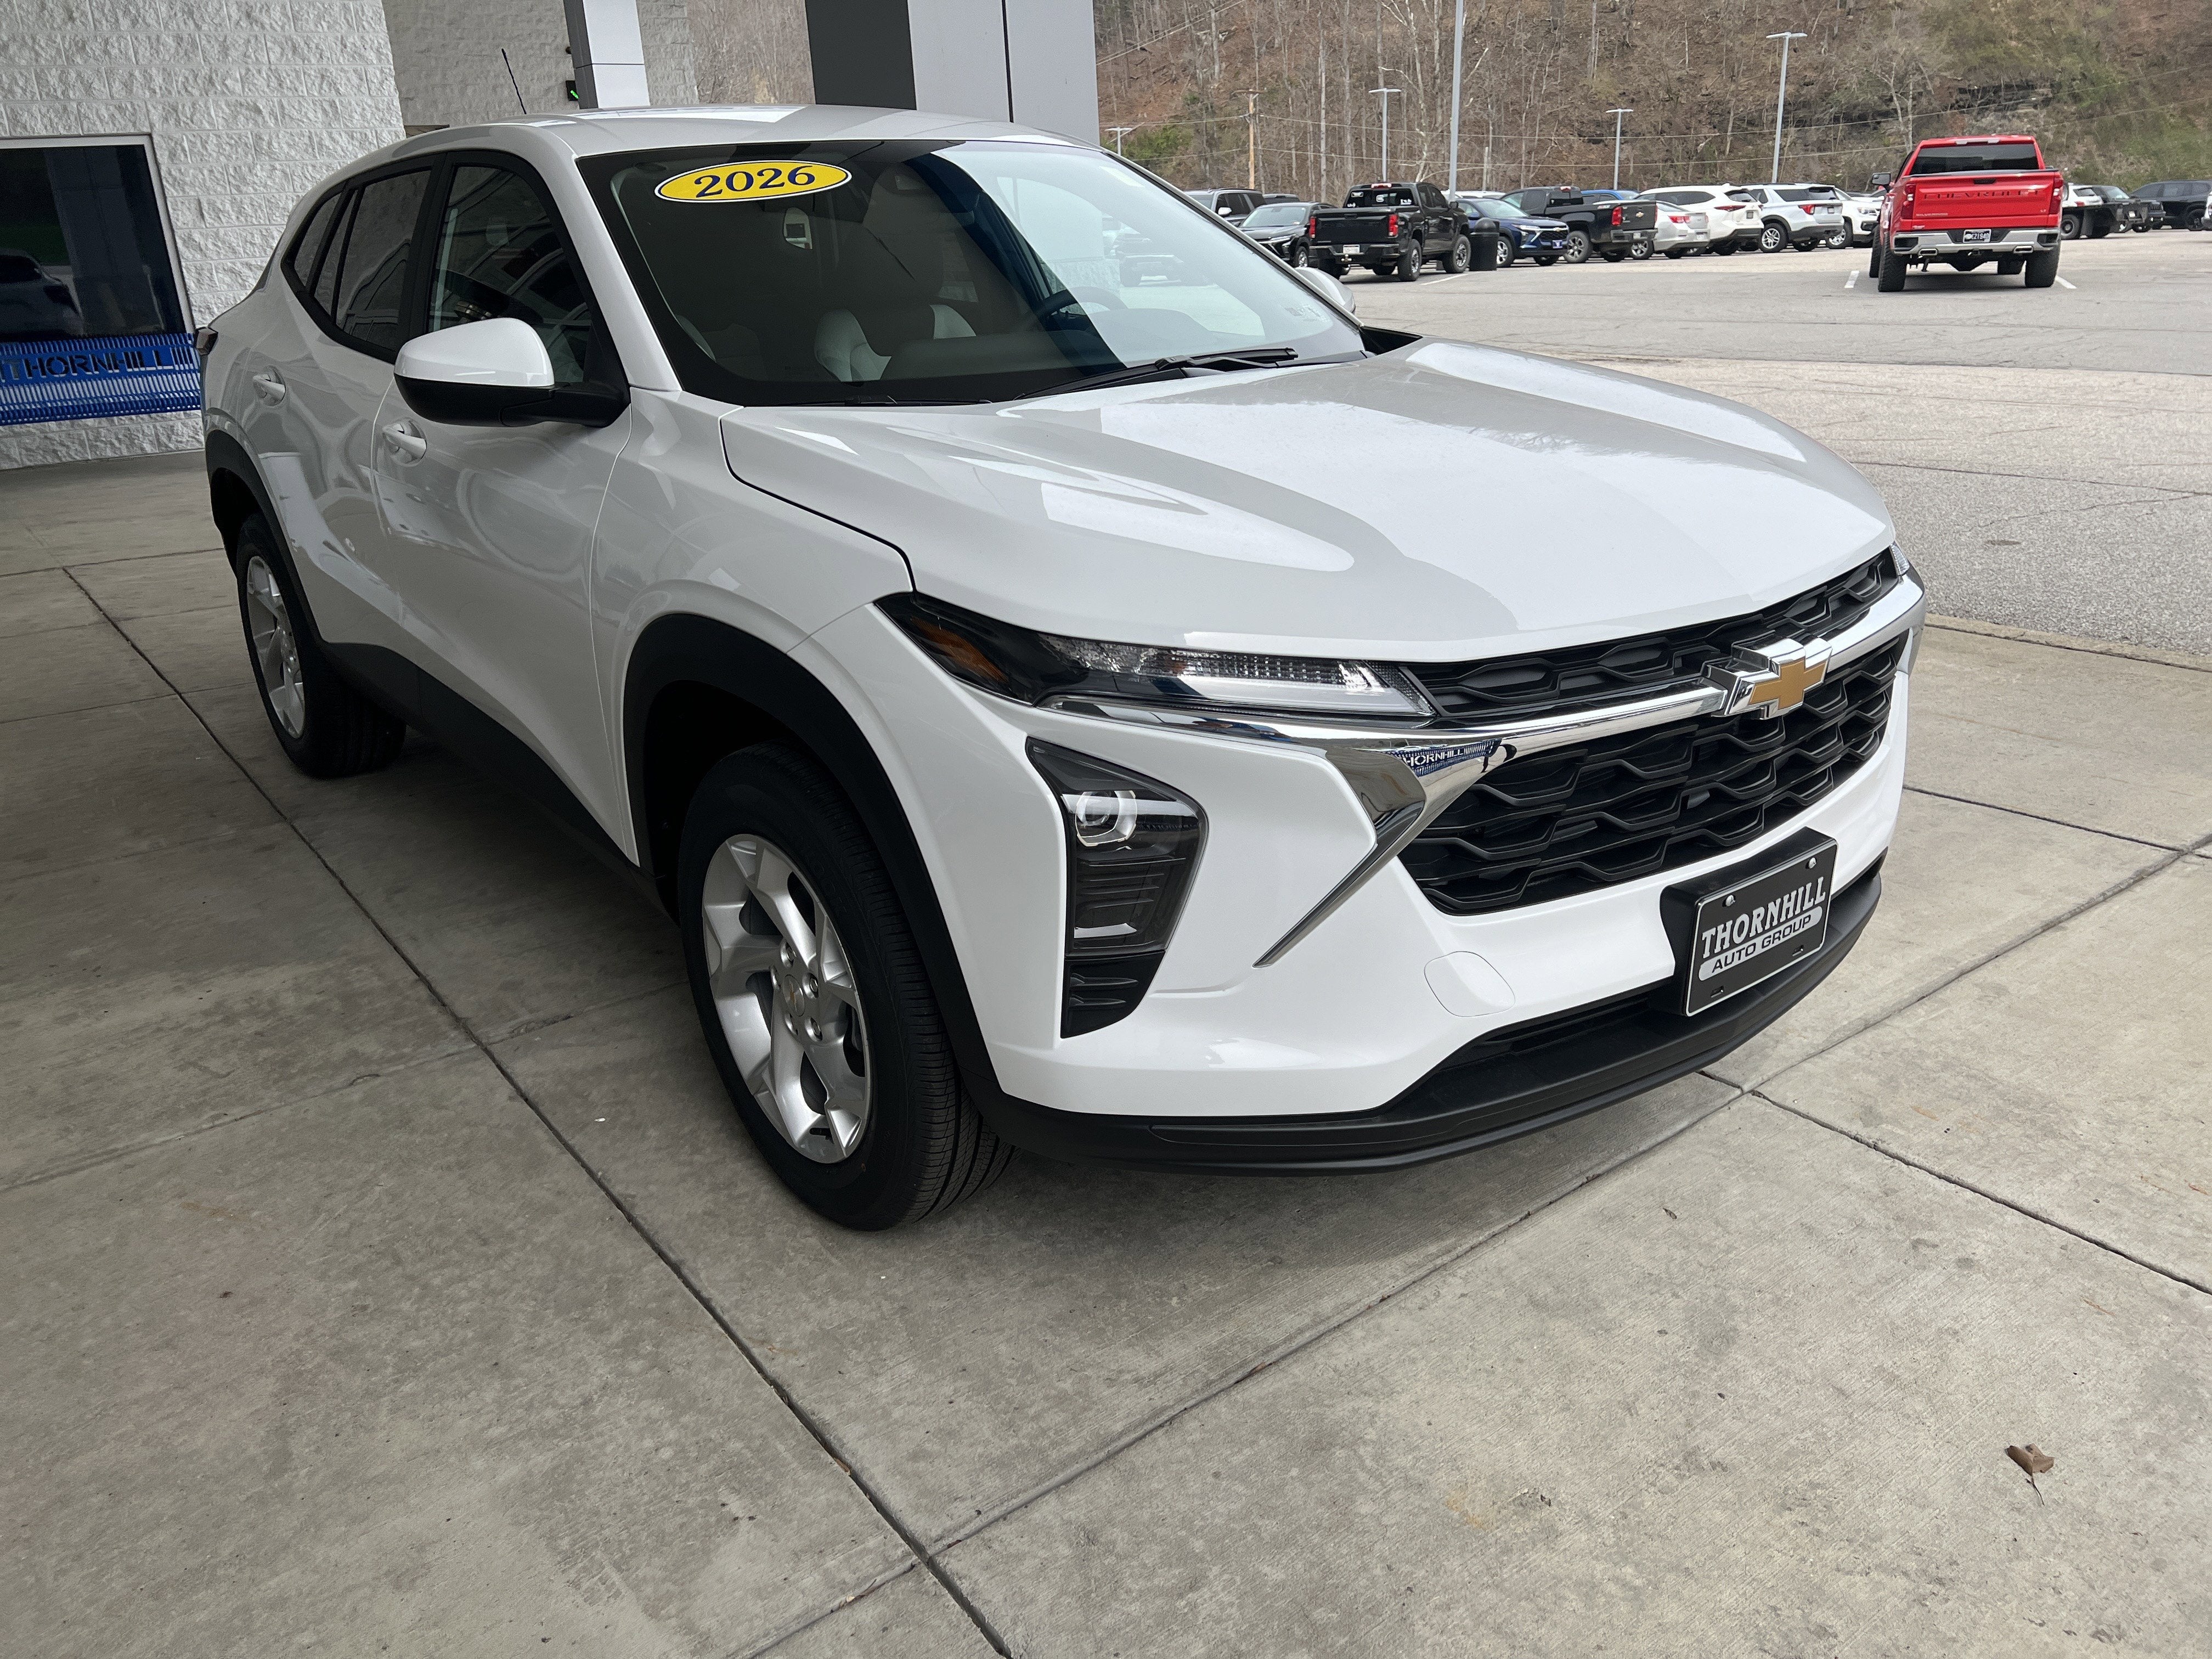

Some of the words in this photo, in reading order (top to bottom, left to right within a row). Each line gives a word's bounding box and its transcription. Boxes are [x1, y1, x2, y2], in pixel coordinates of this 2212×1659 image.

[693, 165, 816, 198] 2026
[4, 350, 173, 380] THORNHILL
[1402, 749, 1464, 767] HORNHILL
[1702, 876, 1826, 958] THORNHILL
[1711, 942, 1757, 973] AUTO
[1761, 913, 1812, 949] GROUP
